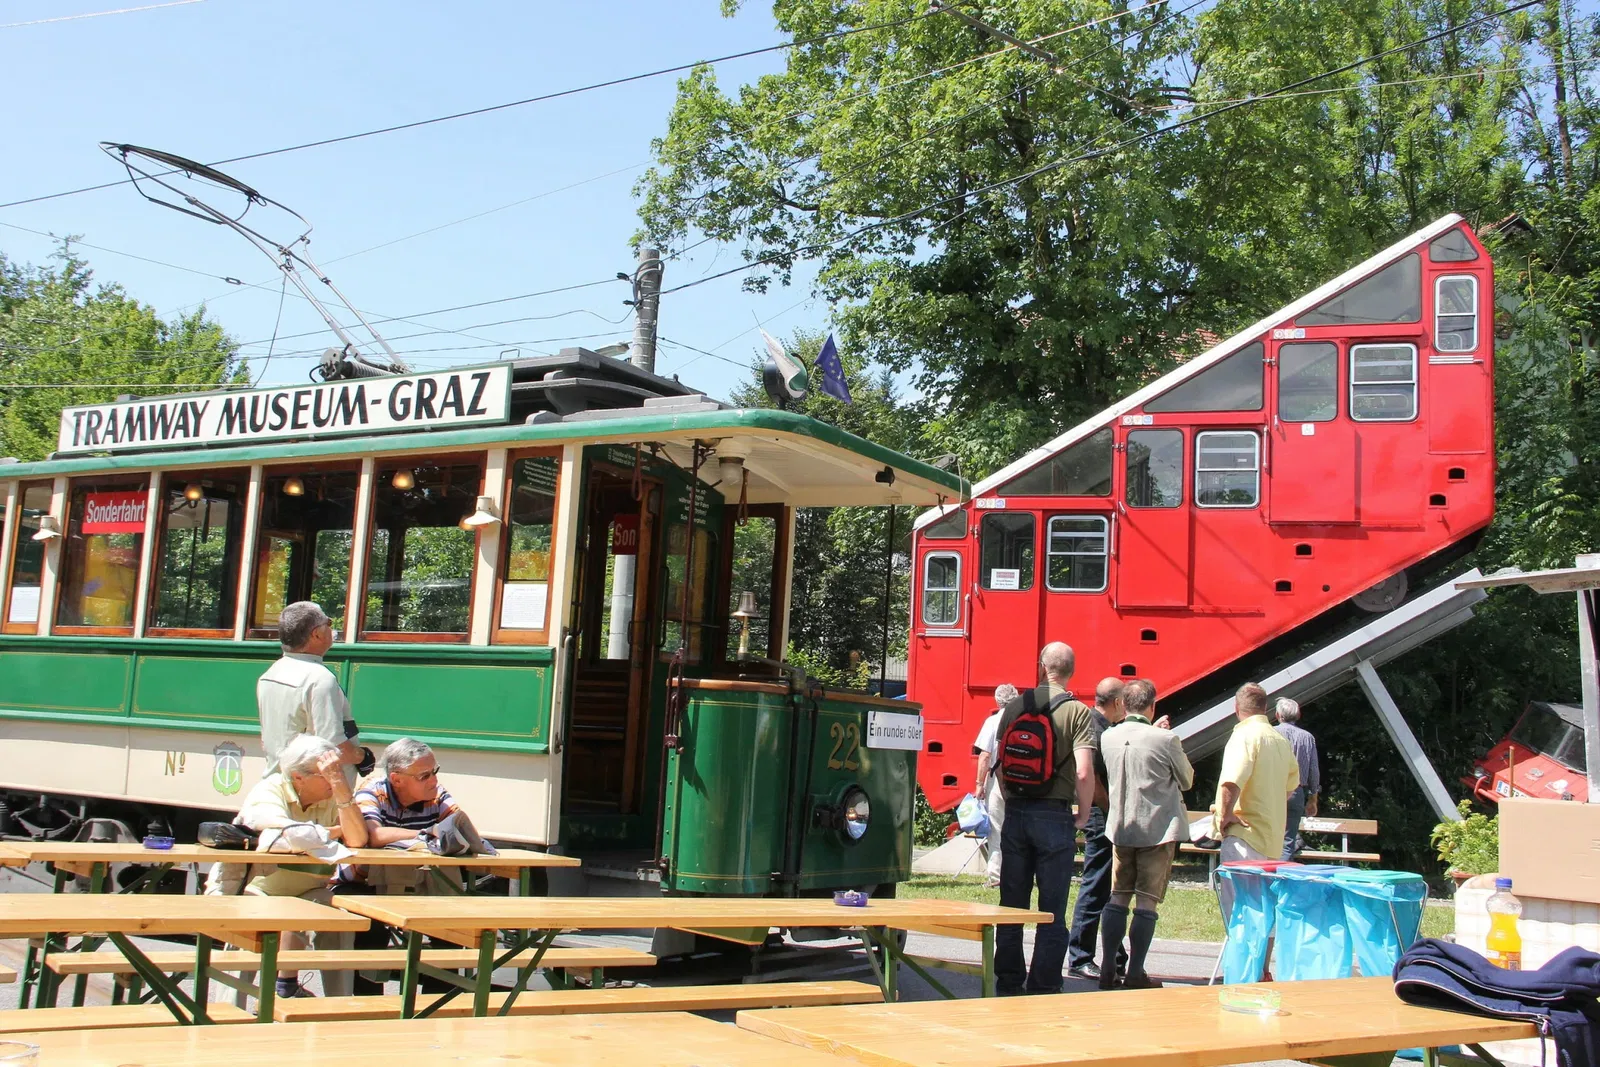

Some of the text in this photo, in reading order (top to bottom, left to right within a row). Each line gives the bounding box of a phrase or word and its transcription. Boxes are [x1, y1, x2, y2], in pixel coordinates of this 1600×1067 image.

[72, 400, 209, 446] TRAMWAY
[86, 499, 145, 523] Sonderfahrt
[615, 523, 636, 546] Son
[869, 722, 922, 740] Ein runder 50er
[827, 721, 861, 771] 22
